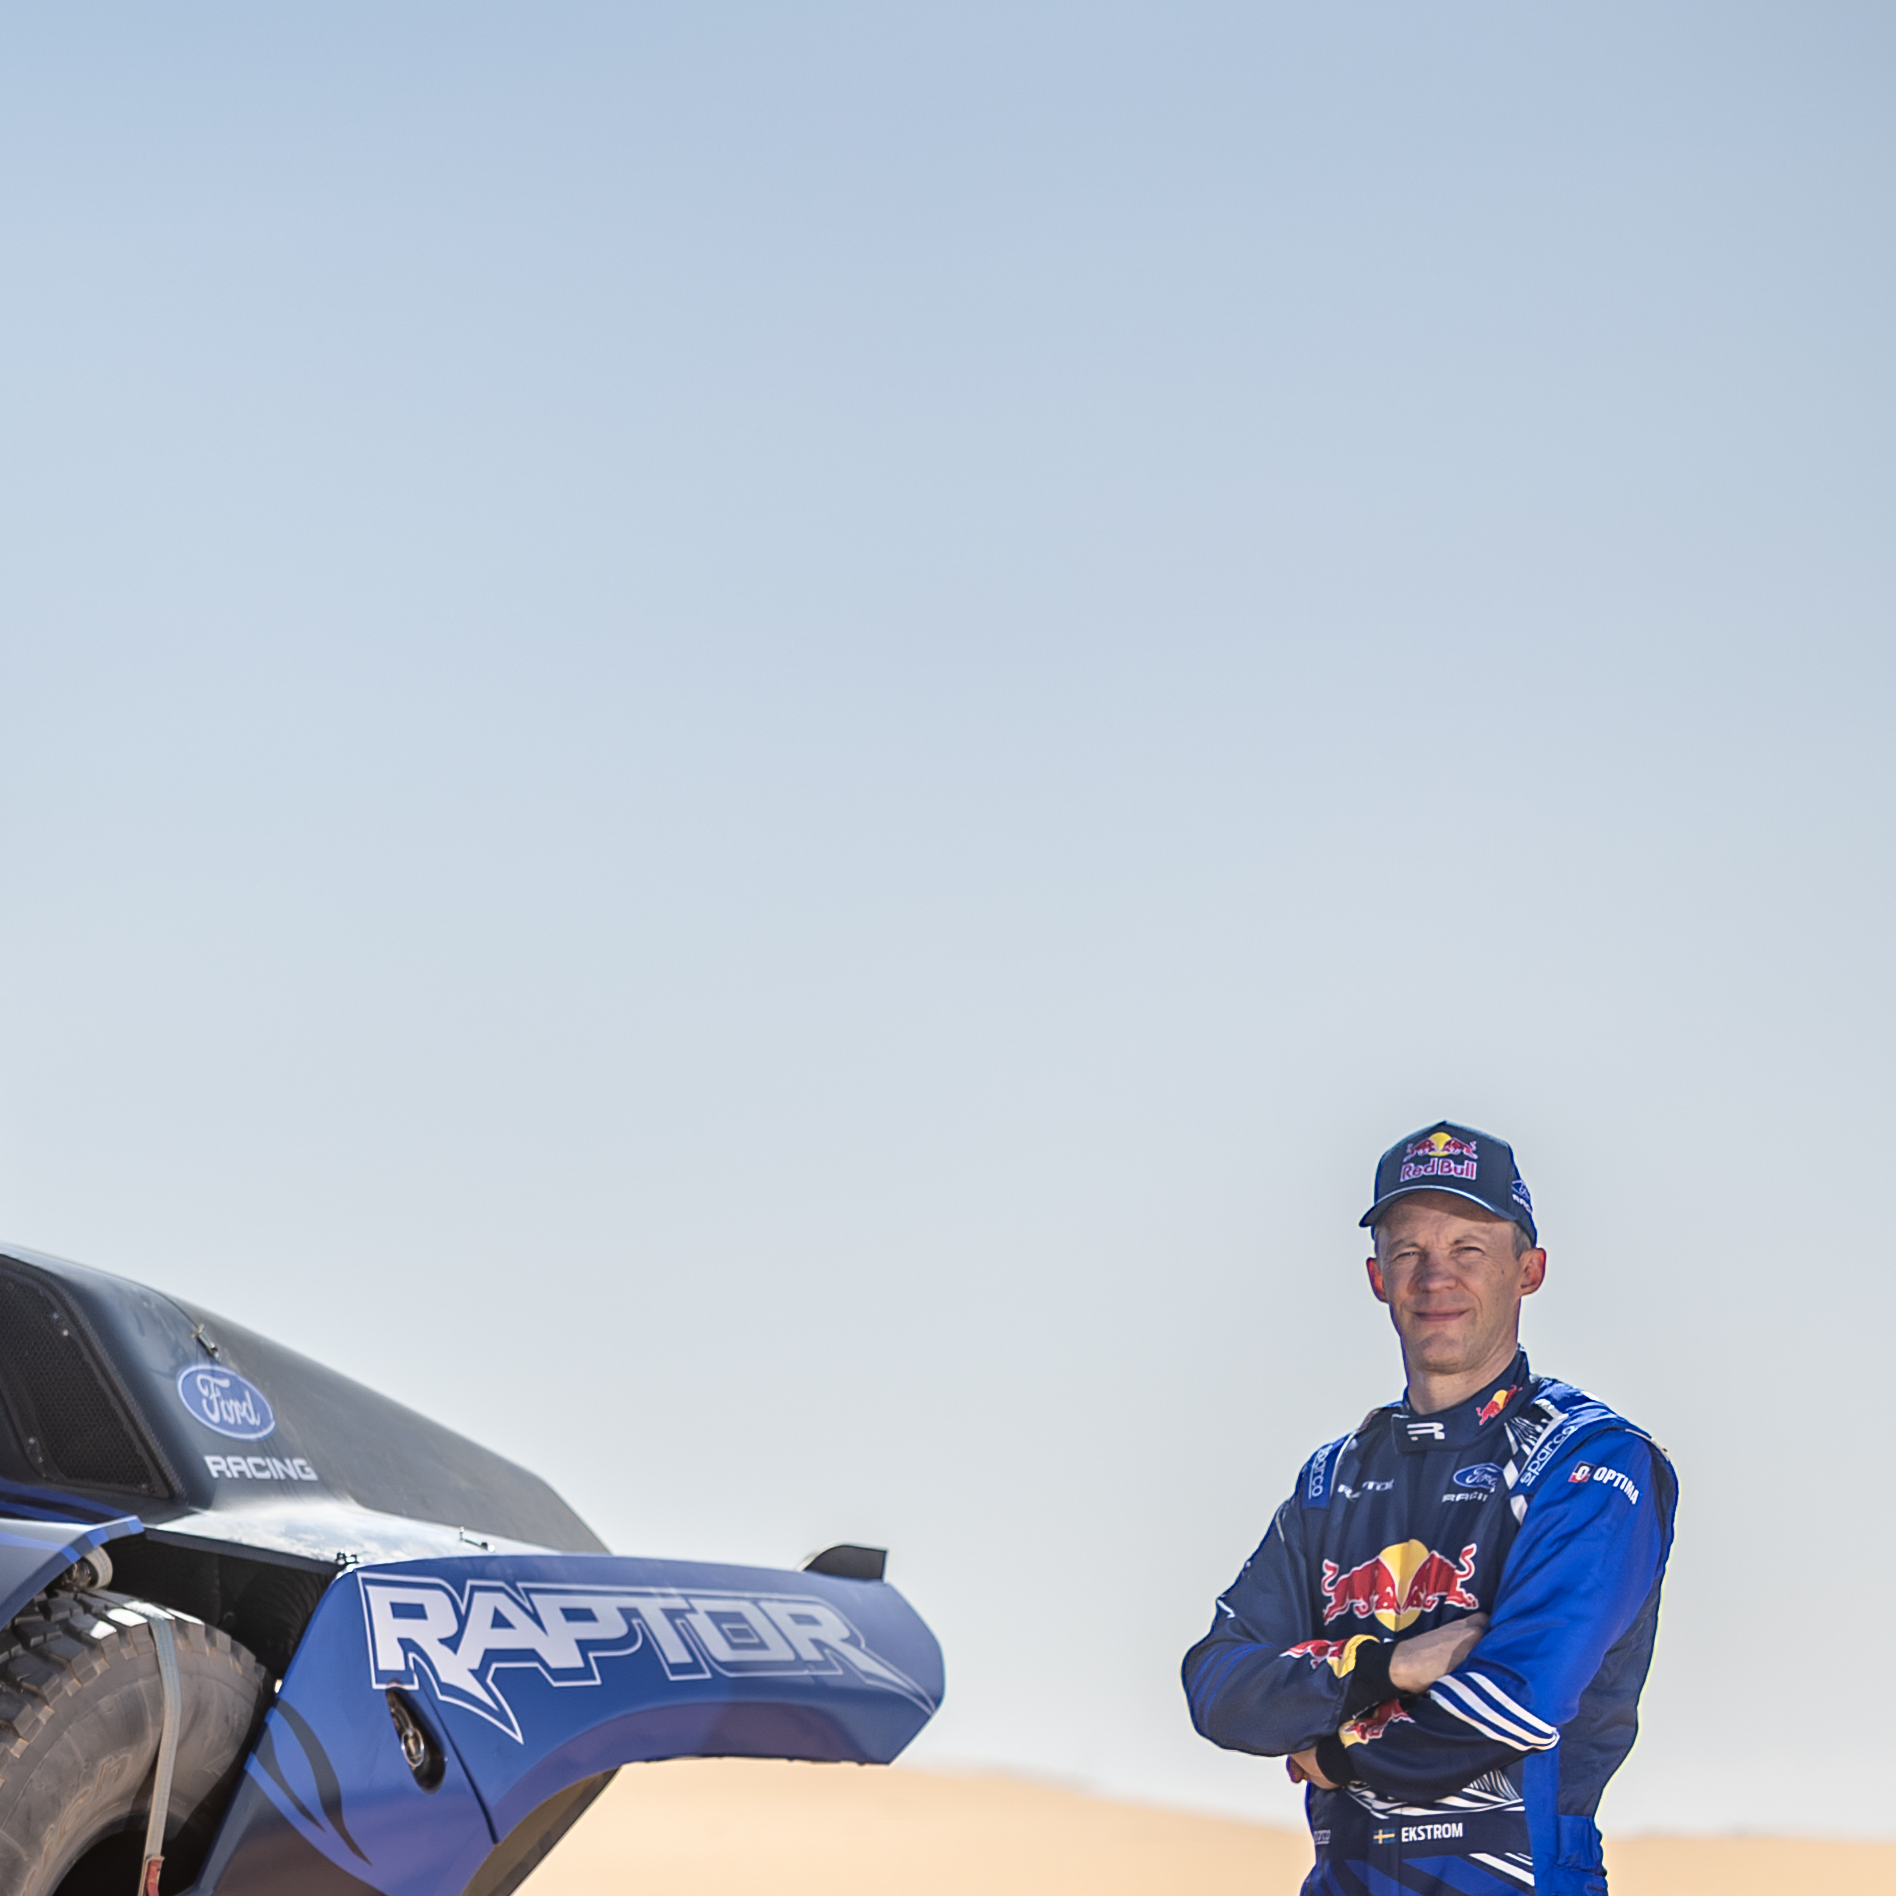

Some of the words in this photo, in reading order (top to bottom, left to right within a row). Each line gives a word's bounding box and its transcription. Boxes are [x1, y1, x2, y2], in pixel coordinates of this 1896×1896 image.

[1400, 1157, 1437, 1182] Red
[1438, 1157, 1477, 1180] Bull
[196, 1373, 261, 1426] Ford
[204, 1455, 318, 1481] RACING
[1520, 1425, 1578, 1487] sparco
[1593, 1466, 1639, 1505] OPTIMA
[357, 1572, 942, 1744] RAPTOR
[1401, 1823, 1464, 1842] EKSTROM
